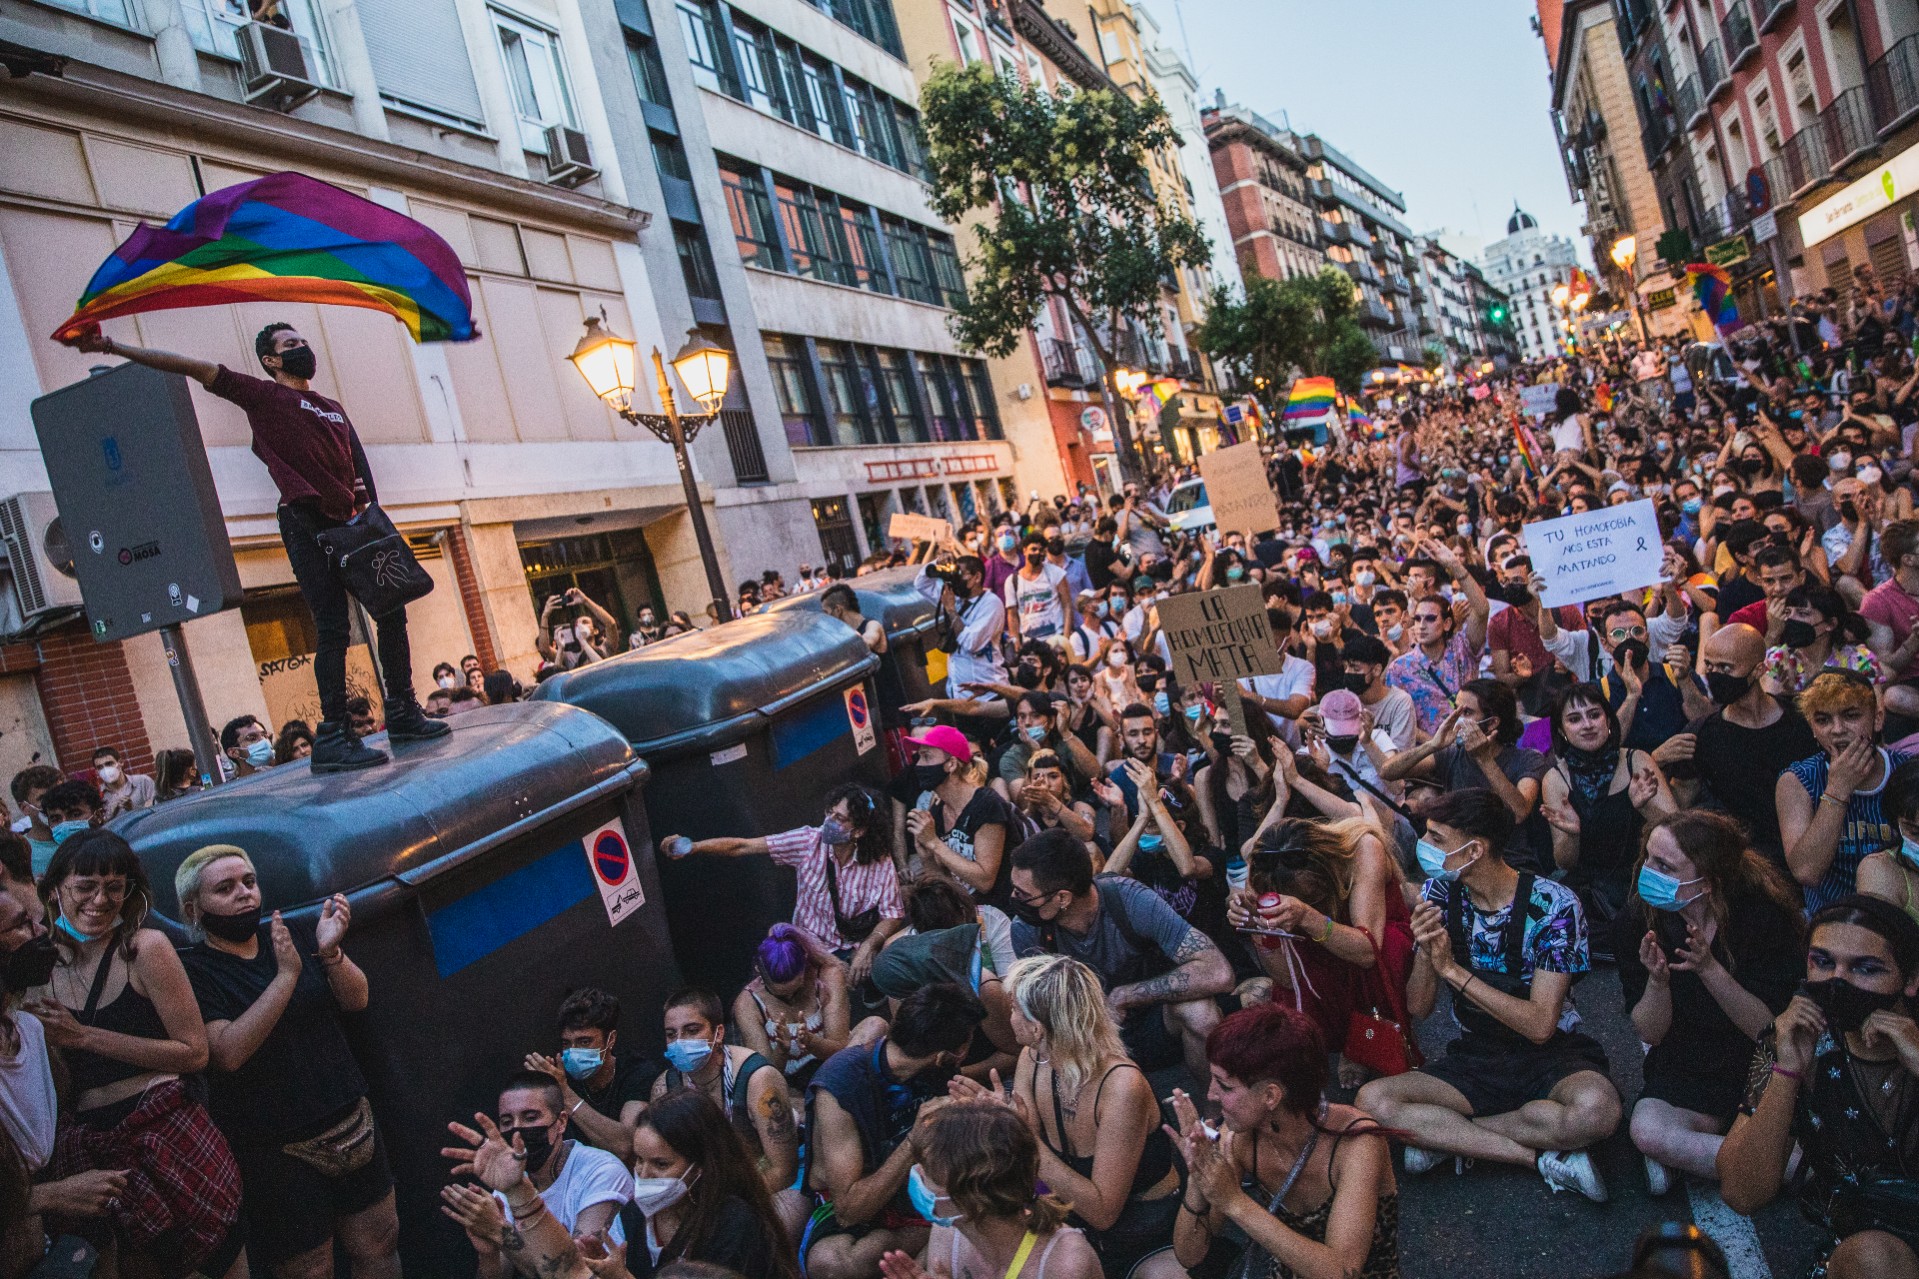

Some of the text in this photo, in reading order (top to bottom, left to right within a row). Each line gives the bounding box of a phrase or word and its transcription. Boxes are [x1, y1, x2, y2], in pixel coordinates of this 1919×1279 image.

[1544, 516, 1636, 543] TU HOMOFOBIA
[134, 546, 161, 562] MOSA
[1563, 544, 1583, 556] NOS
[1557, 554, 1616, 575] MATANDO
[1201, 595, 1229, 621] LA
[1168, 614, 1271, 651] HOMOFOBIA
[1186, 644, 1264, 680] MATA
